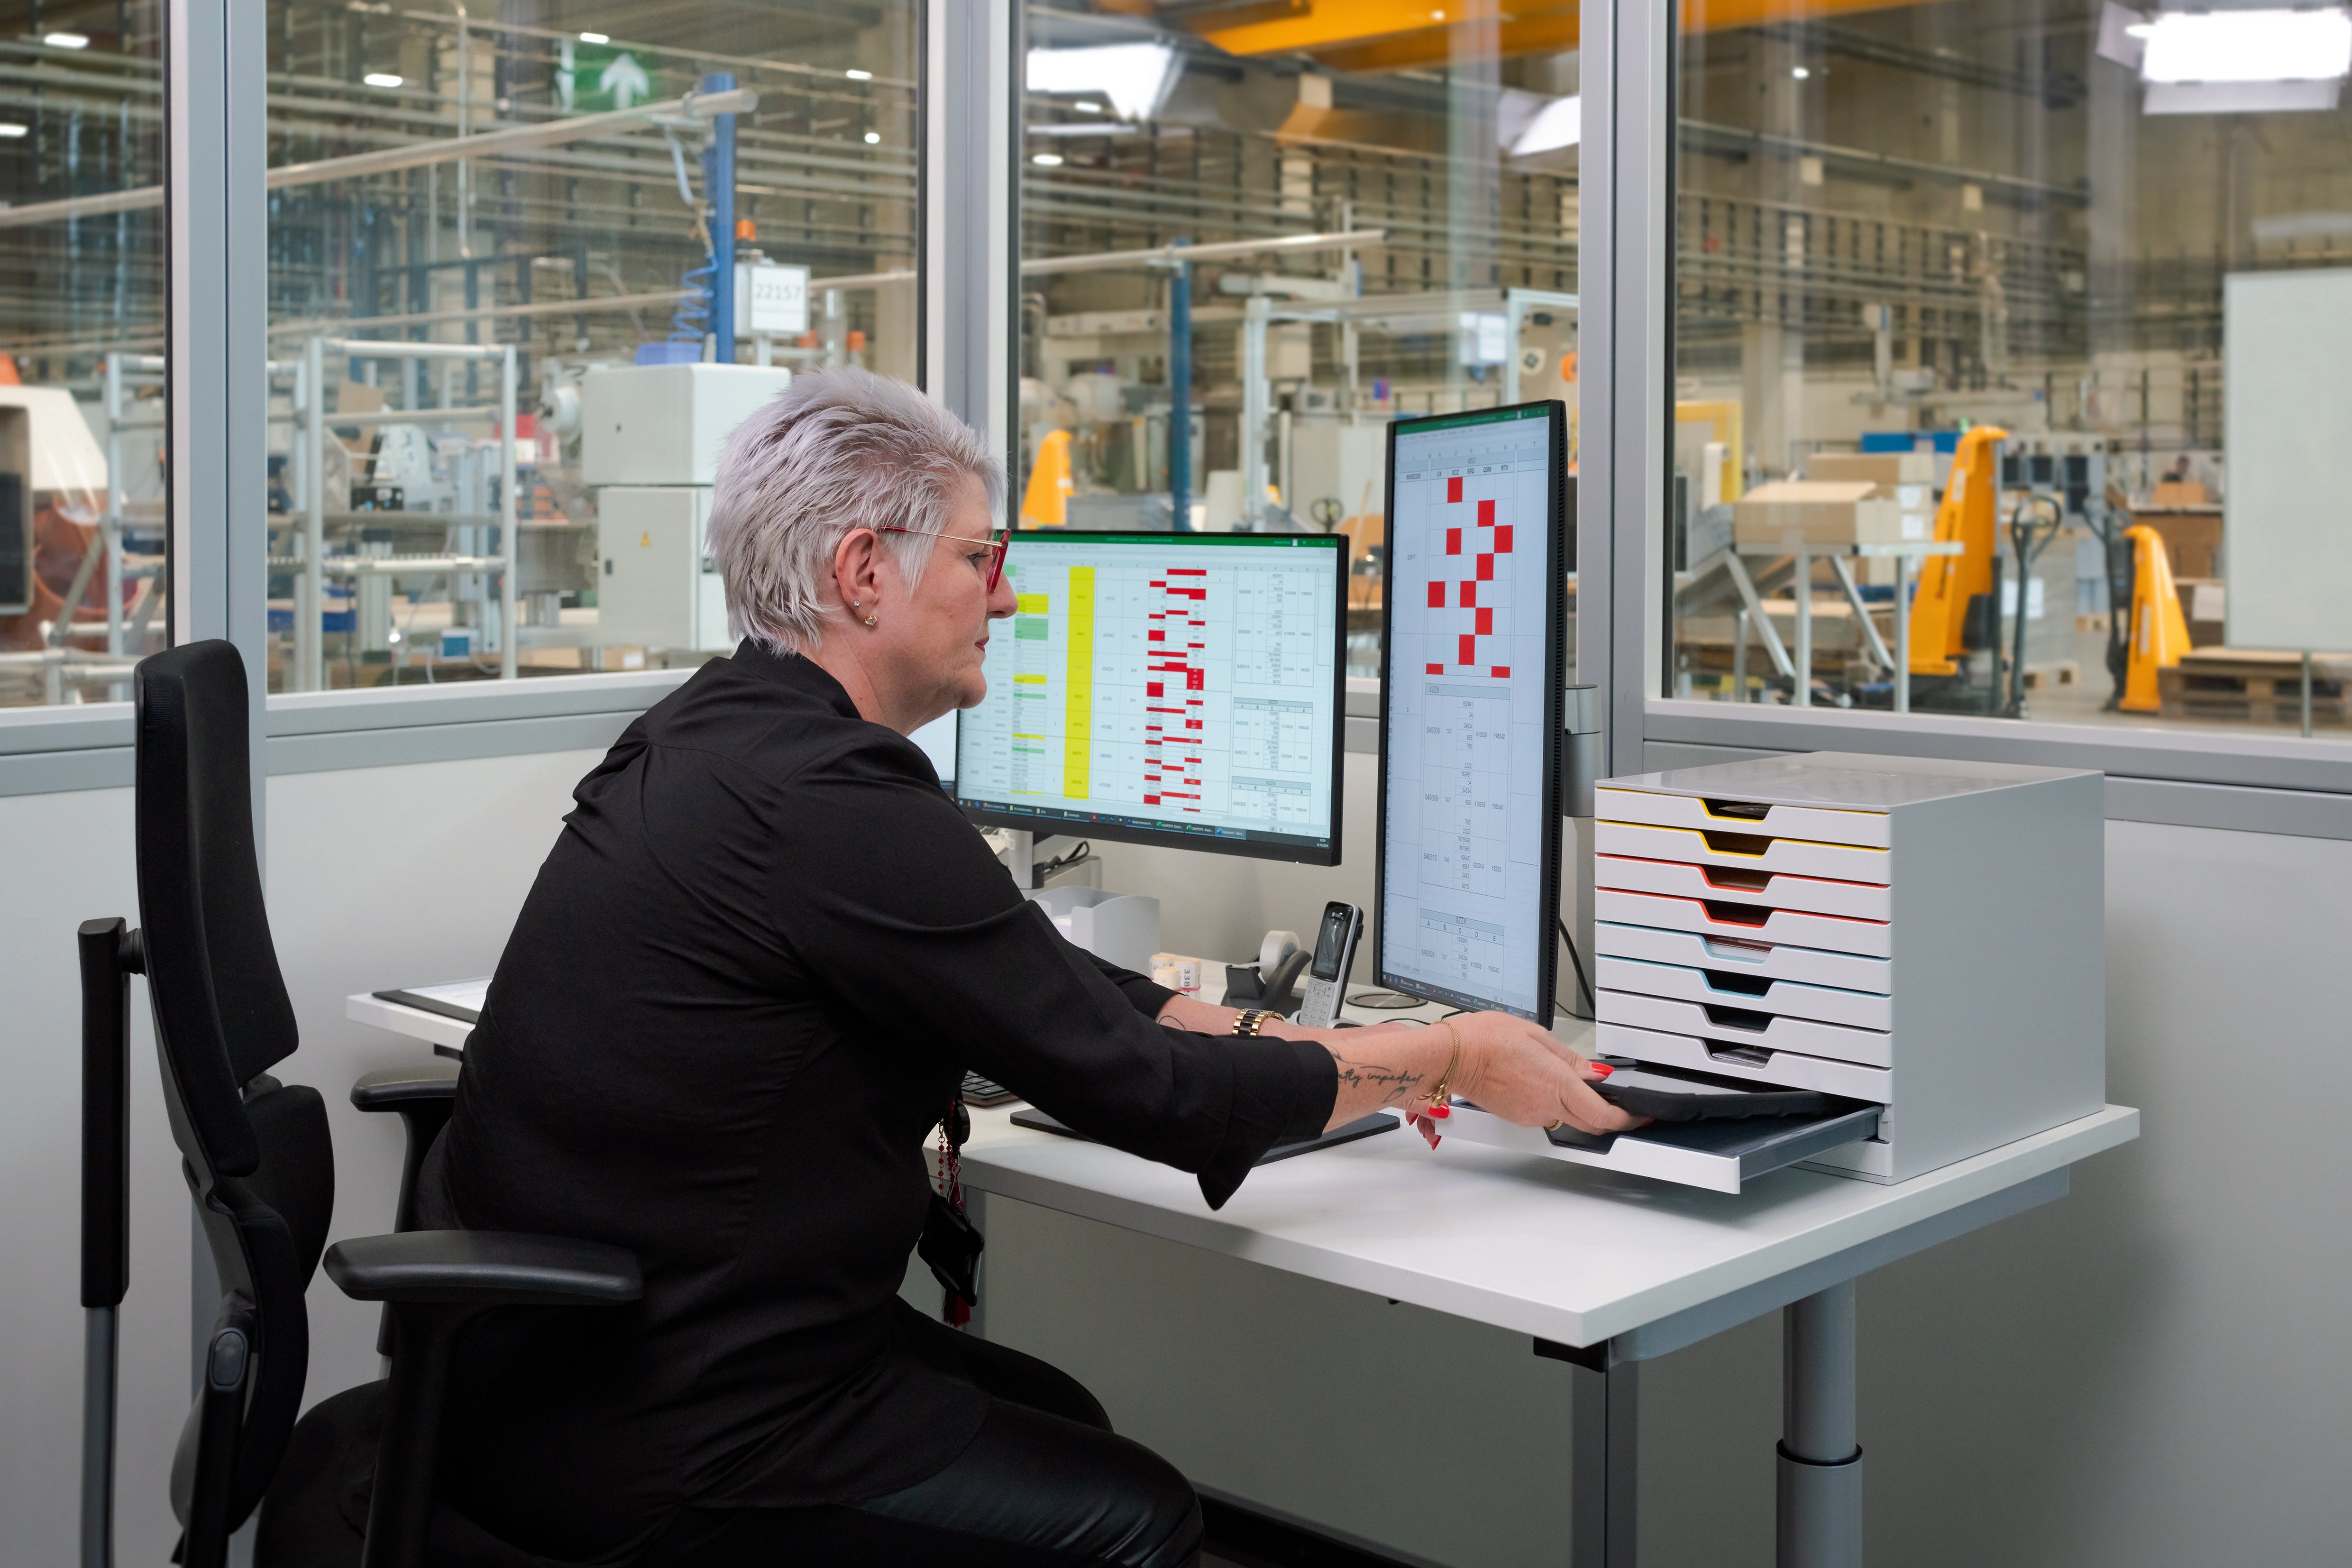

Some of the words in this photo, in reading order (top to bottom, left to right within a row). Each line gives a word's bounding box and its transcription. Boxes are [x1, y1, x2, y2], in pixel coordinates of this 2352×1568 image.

[755, 283, 801, 301] 22157
[1425, 793, 1438, 801] 649309
[1423, 853, 1437, 861] 649310
[1455, 916, 1466, 925] XZZX
[1421, 949, 1435, 958] 649309
[1488, 965, 1500, 973] Y98340
[1367, 1070, 1425, 1086] imperfect
